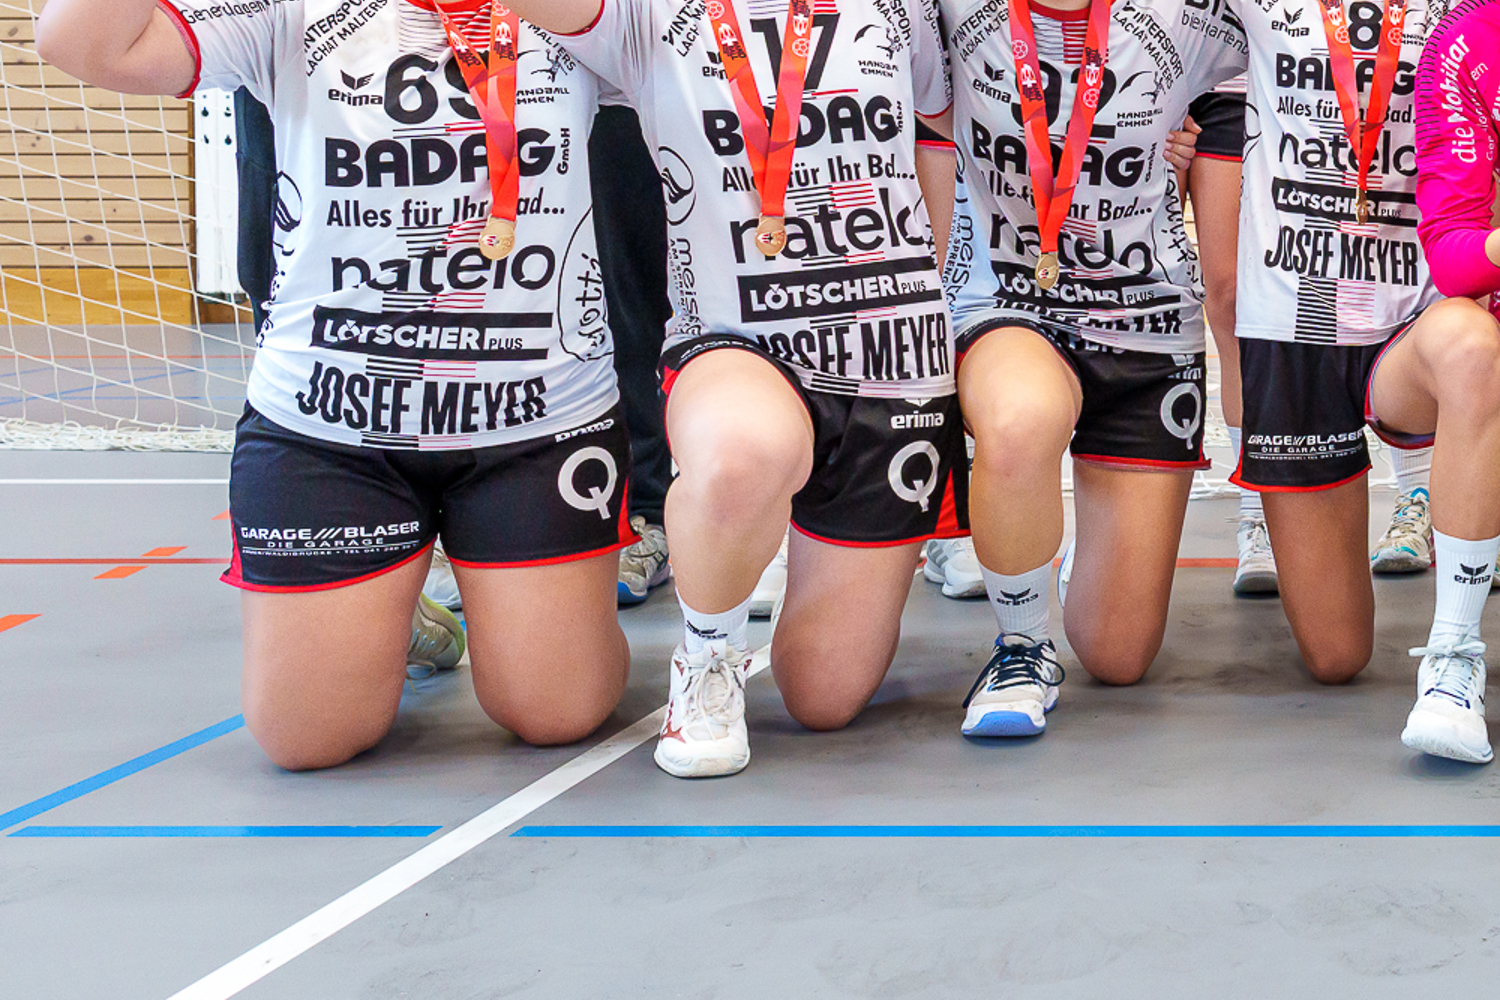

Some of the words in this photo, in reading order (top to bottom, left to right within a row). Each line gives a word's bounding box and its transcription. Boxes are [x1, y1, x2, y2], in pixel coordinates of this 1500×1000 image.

[306, 36, 340, 78] LACHAT
[751, 13, 841, 92] 17
[1144, 43, 1175, 90] MALTERS
[328, 88, 384, 107] erima
[1277, 96, 1312, 118] Alles
[702, 95, 900, 156] BDAG
[1117, 118, 1154, 128] EMMEN
[557, 127, 571, 176] GmbH
[1451, 126, 1477, 163] die
[829, 155, 862, 184] Ihr
[326, 199, 393, 229] Alles
[401, 198, 441, 229] für
[1098, 197, 1152, 222] Bad...
[331, 244, 556, 294] natelo
[1264, 225, 1334, 280] JOSEF
[1339, 233, 1419, 287] MEYER
[900, 279, 928, 294] PLUS
[1126, 290, 1156, 304] PLUS
[488, 337, 524, 351] PLUS
[860, 313, 951, 381] MEYER
[296, 361, 411, 434] JOSEF
[420, 376, 547, 435] MEYER
[890, 411, 944, 430] erima
[267, 541, 294, 549] DIE
[304, 538, 384, 549] GARAGE
[1454, 574, 1491, 586] erima
